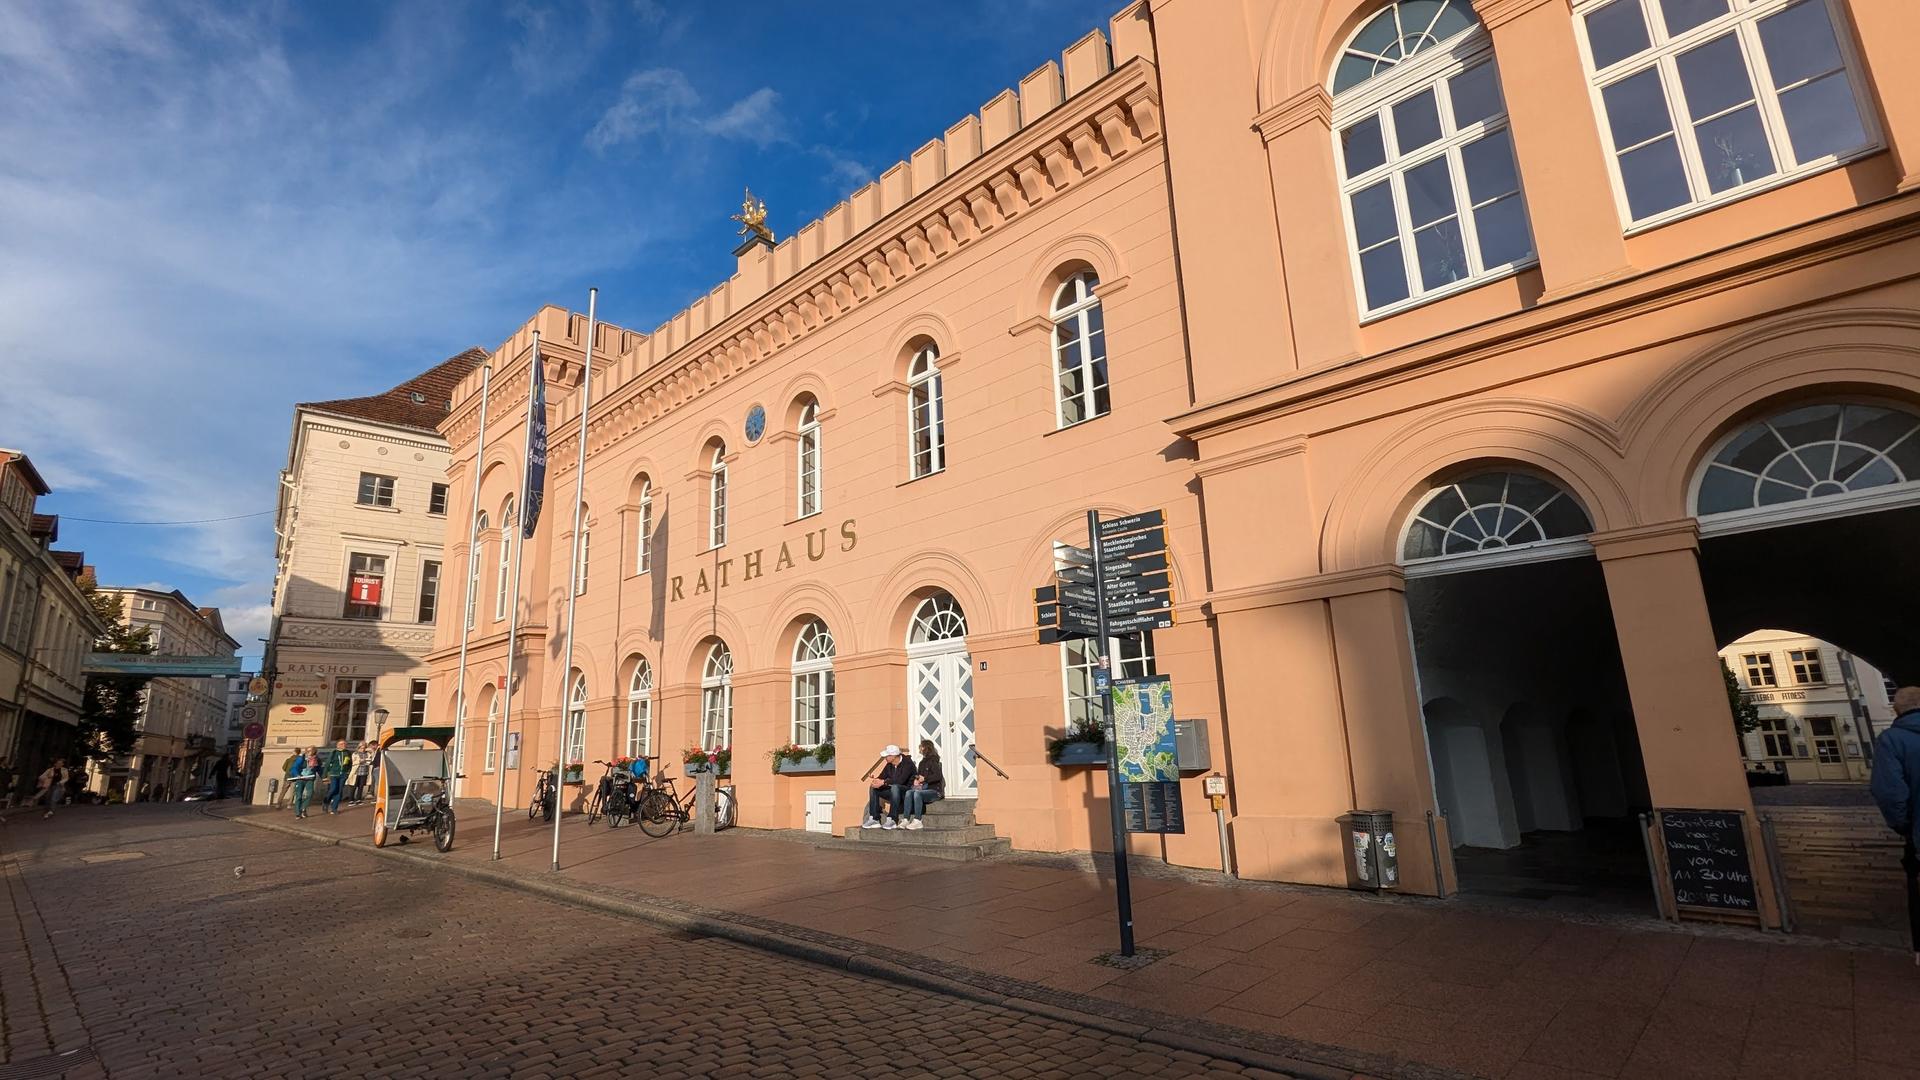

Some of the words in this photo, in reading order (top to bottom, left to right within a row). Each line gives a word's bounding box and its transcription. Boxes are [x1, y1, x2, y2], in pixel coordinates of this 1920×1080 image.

[1119, 517, 1141, 526] Schwerin
[1103, 534, 1147, 547] Mecklenburgisches
[1103, 543, 1135, 554] Staatstheater
[670, 518, 858, 603] RATHAUS
[1119, 580, 1136, 588] Garten
[1108, 600, 1134, 609] Staatliches
[1134, 597, 1156, 605] Museum
[287, 664, 359, 673] RATSHOF
[282, 689, 319, 698] ADRIA
[1781, 691, 1806, 700] FITNESS
[1687, 857, 1714, 867] von
[1726, 871, 1750, 882] Uhr
[1723, 894, 1750, 906] Uhr
